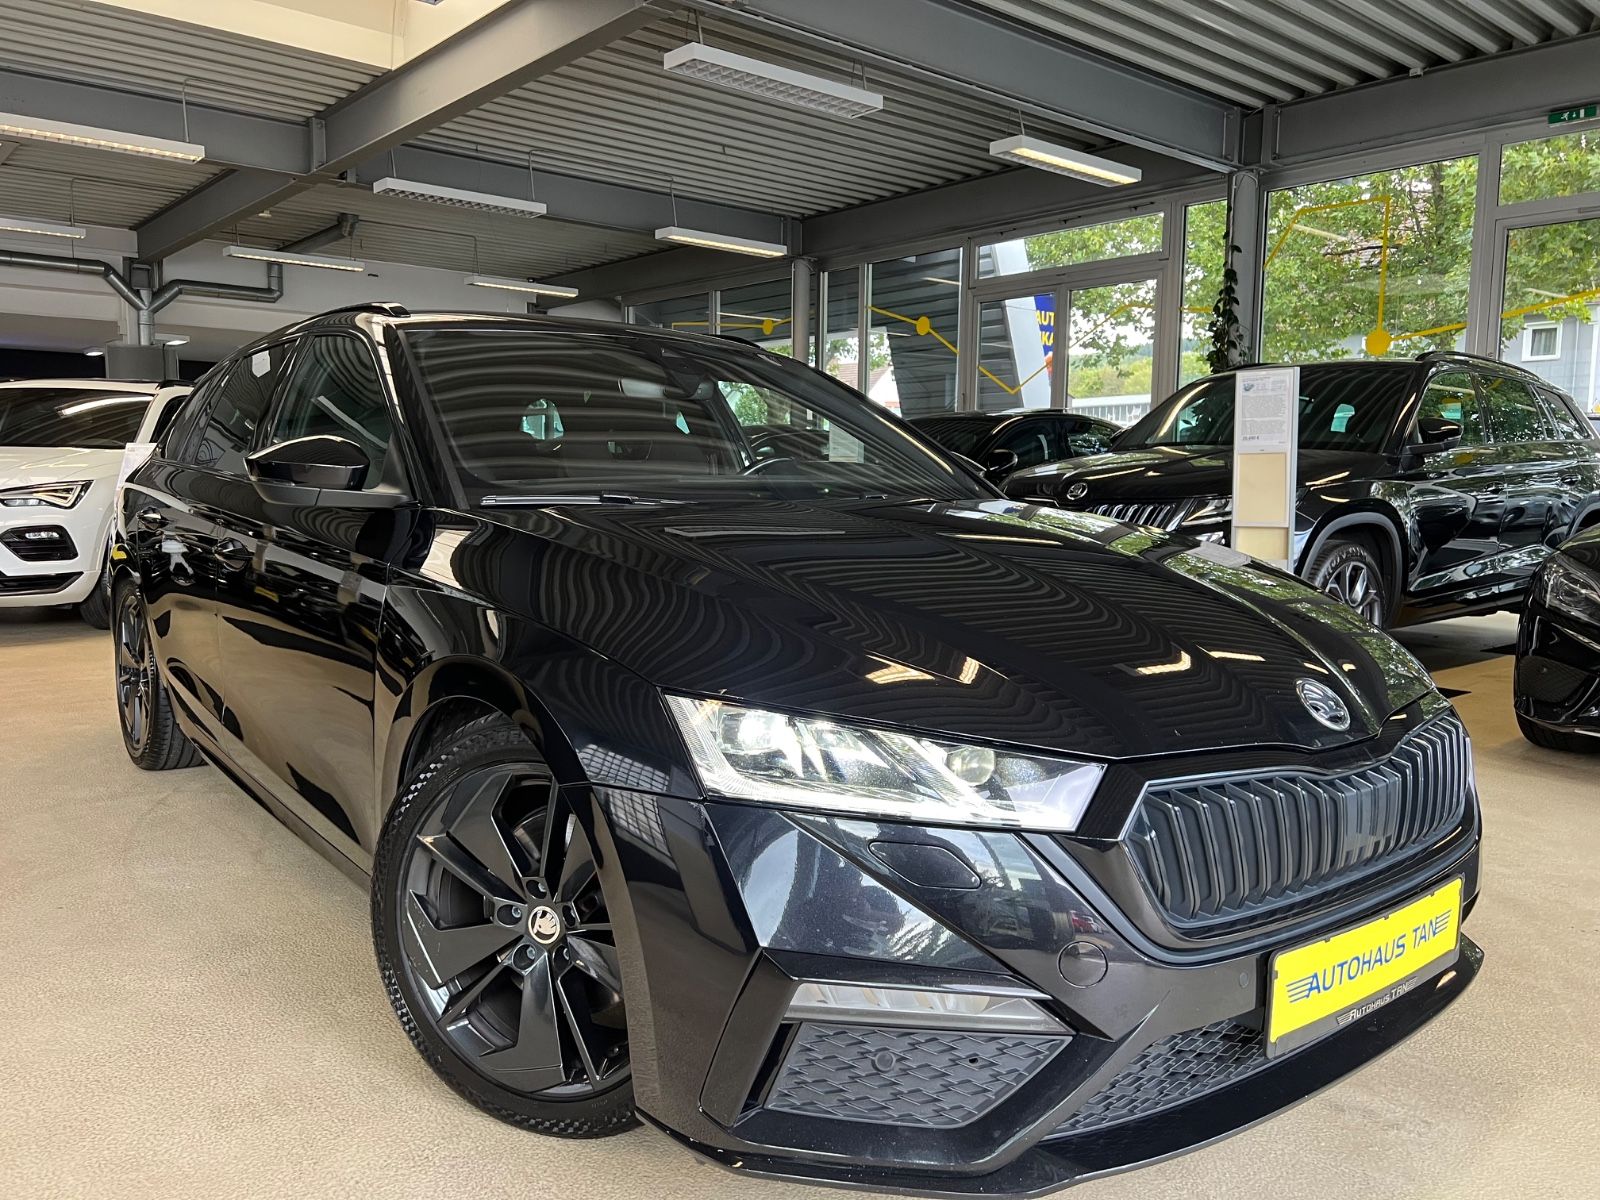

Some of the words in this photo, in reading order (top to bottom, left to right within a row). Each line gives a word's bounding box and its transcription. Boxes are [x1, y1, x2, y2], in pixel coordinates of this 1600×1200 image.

[1306, 934, 1407, 998] AUTOHAUS
[1412, 916, 1439, 949] TAN
[1349, 994, 1390, 1020] AUTOHAUS
[1391, 982, 1408, 999] TAN
